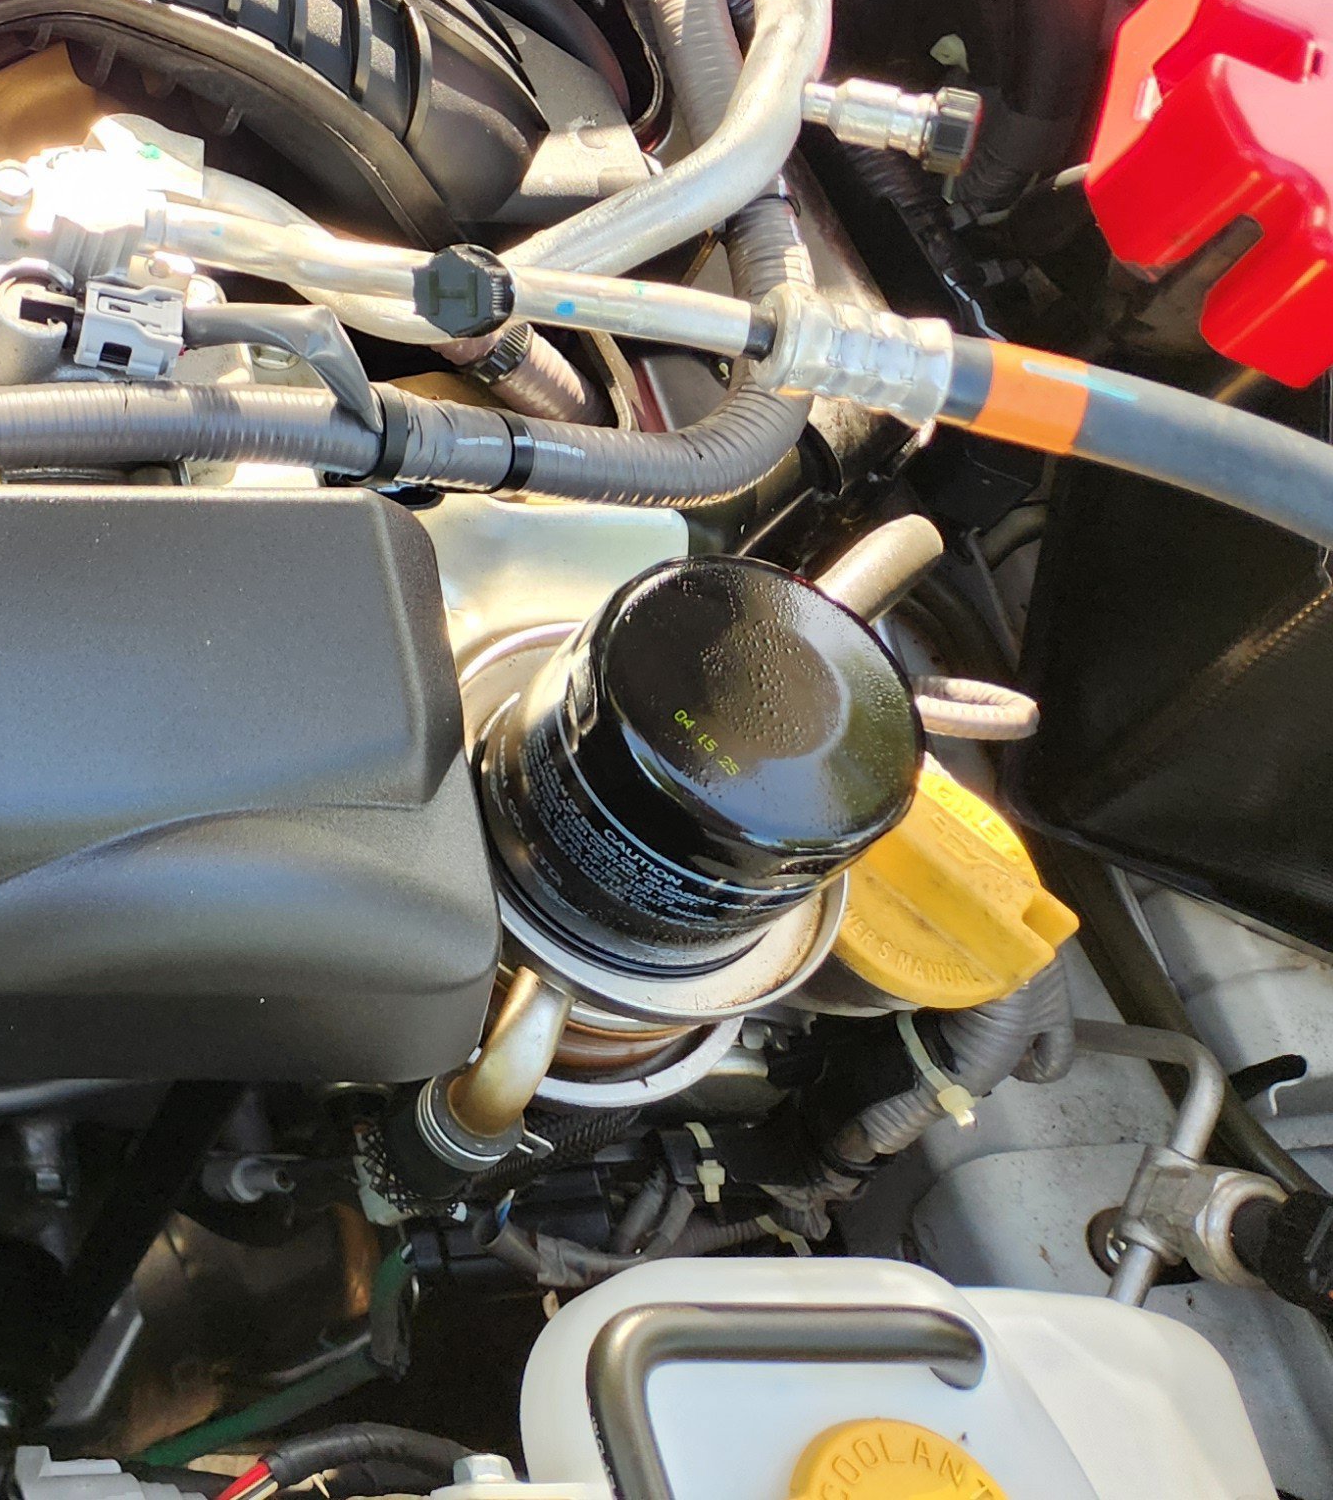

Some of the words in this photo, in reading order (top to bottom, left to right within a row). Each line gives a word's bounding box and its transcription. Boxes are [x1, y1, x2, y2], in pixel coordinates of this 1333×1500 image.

[428, 268, 478, 317] H
[674, 709, 696, 730] 04
[697, 733, 719, 753] 15
[718, 756, 740, 777] 25
[604, 828, 684, 887] CAUTION
[896, 948, 981, 982] MANUAL
